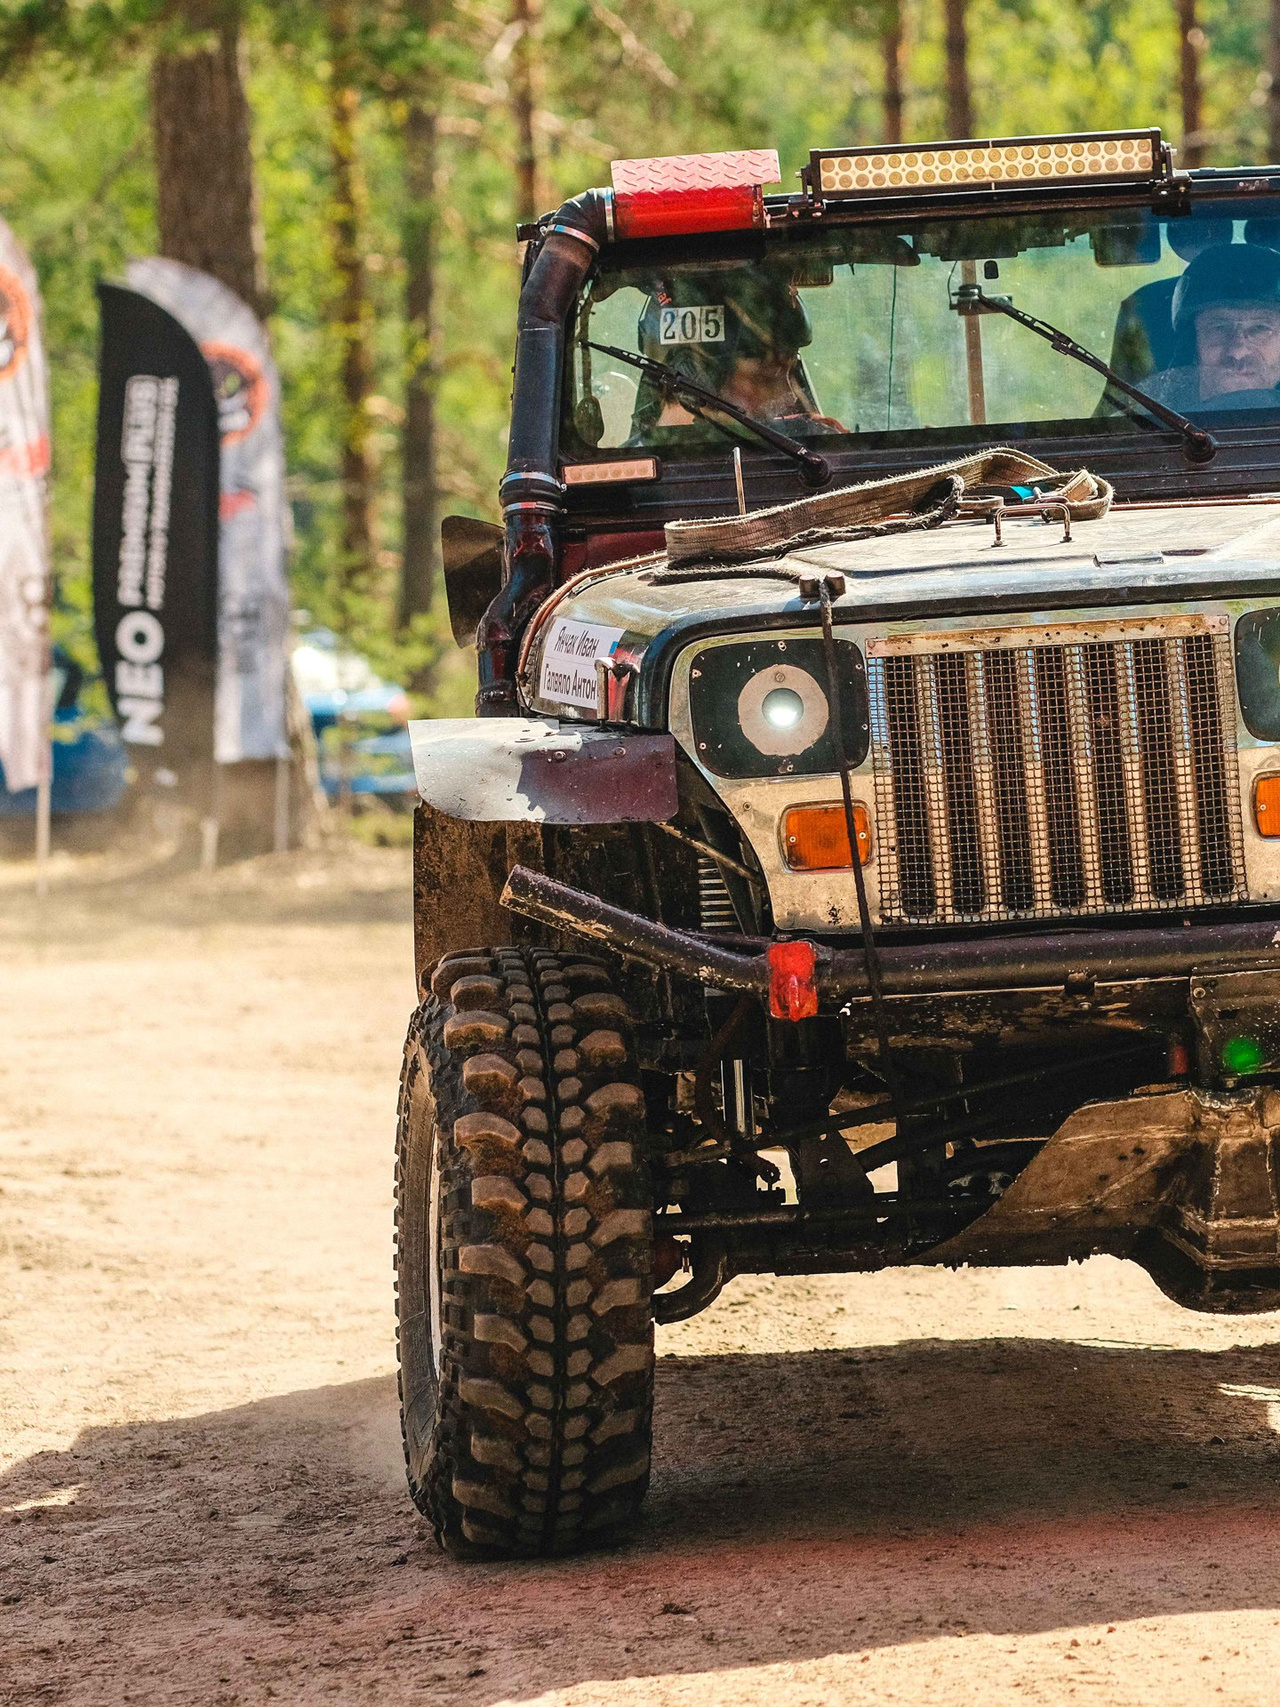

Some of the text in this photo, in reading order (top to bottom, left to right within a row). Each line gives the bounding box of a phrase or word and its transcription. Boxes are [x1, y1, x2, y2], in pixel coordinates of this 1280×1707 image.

[663, 308, 720, 340] 205
[575, 630, 600, 658] Иван
[115, 611, 165, 746] NEO
[571, 669, 597, 701] Антон
